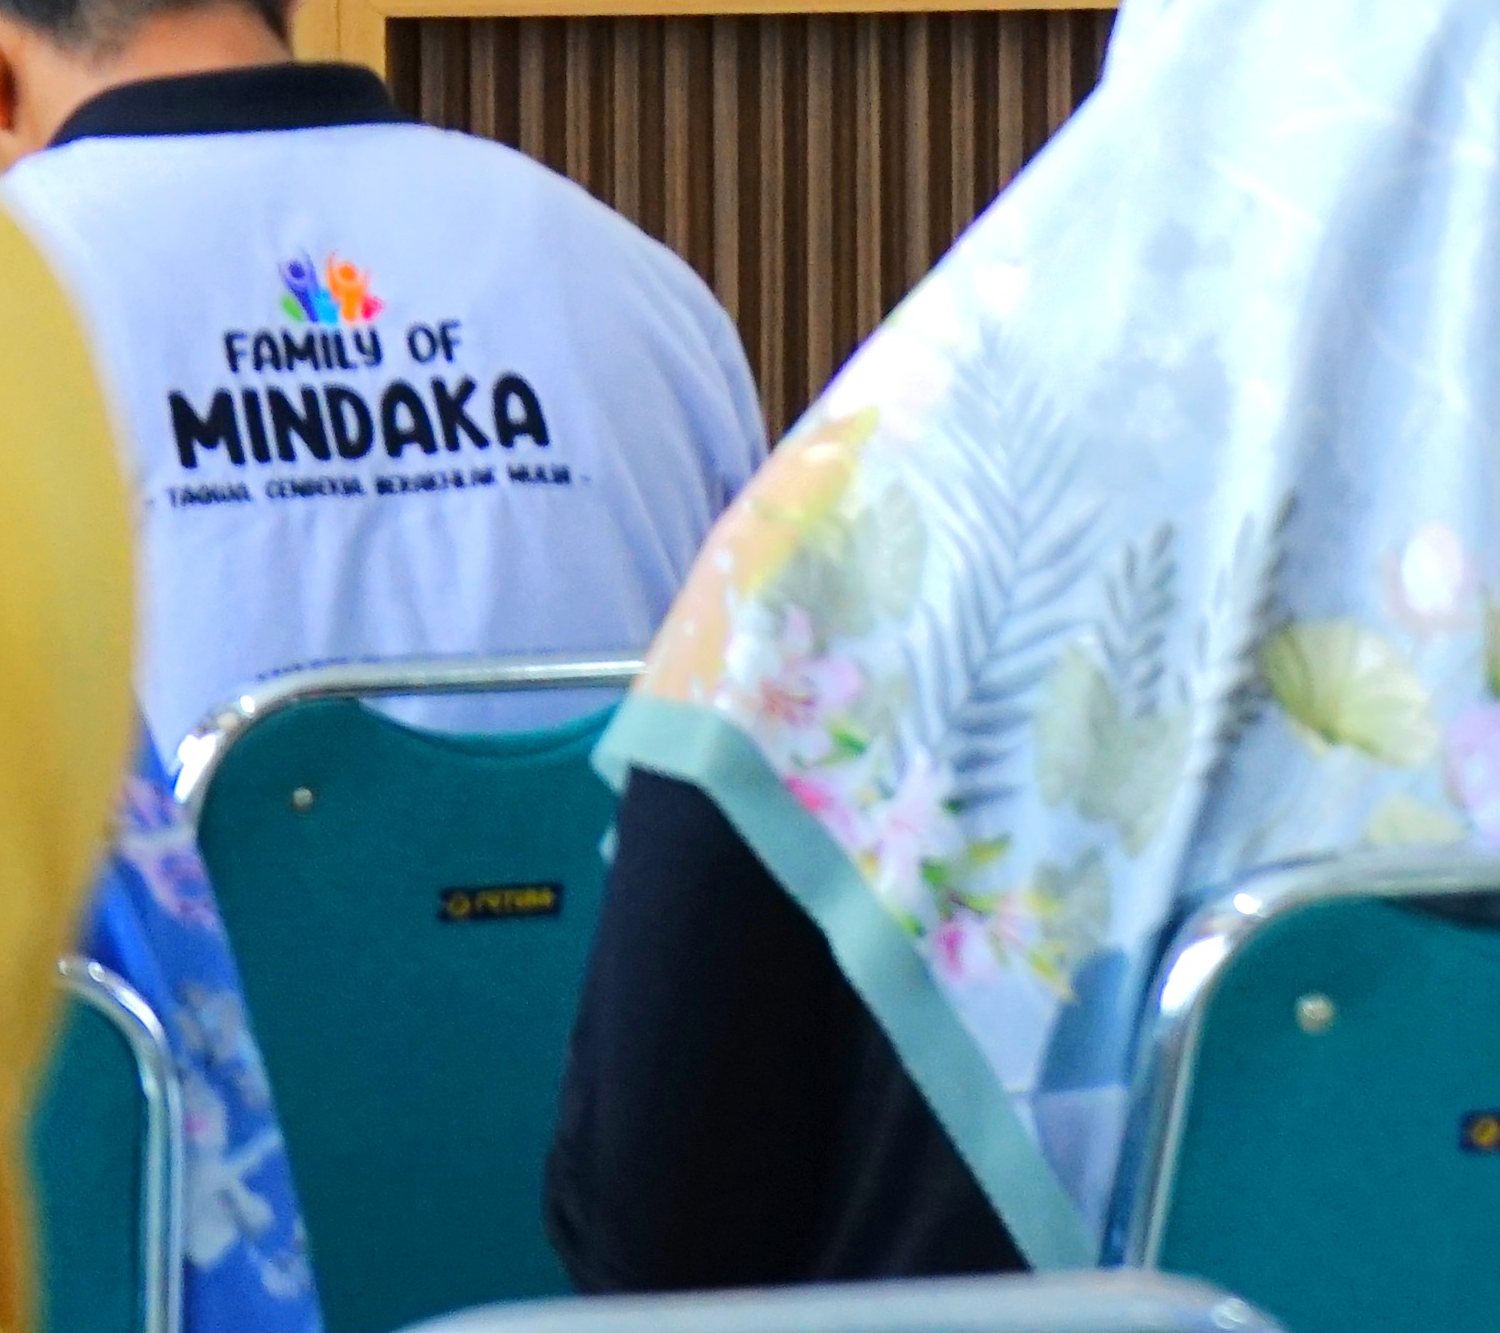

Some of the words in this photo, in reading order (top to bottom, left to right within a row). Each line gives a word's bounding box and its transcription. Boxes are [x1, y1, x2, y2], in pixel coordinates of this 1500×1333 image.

[223, 326, 384, 373] FAMILY
[406, 318, 462, 365] OF
[167, 371, 552, 470] MINDAKA
